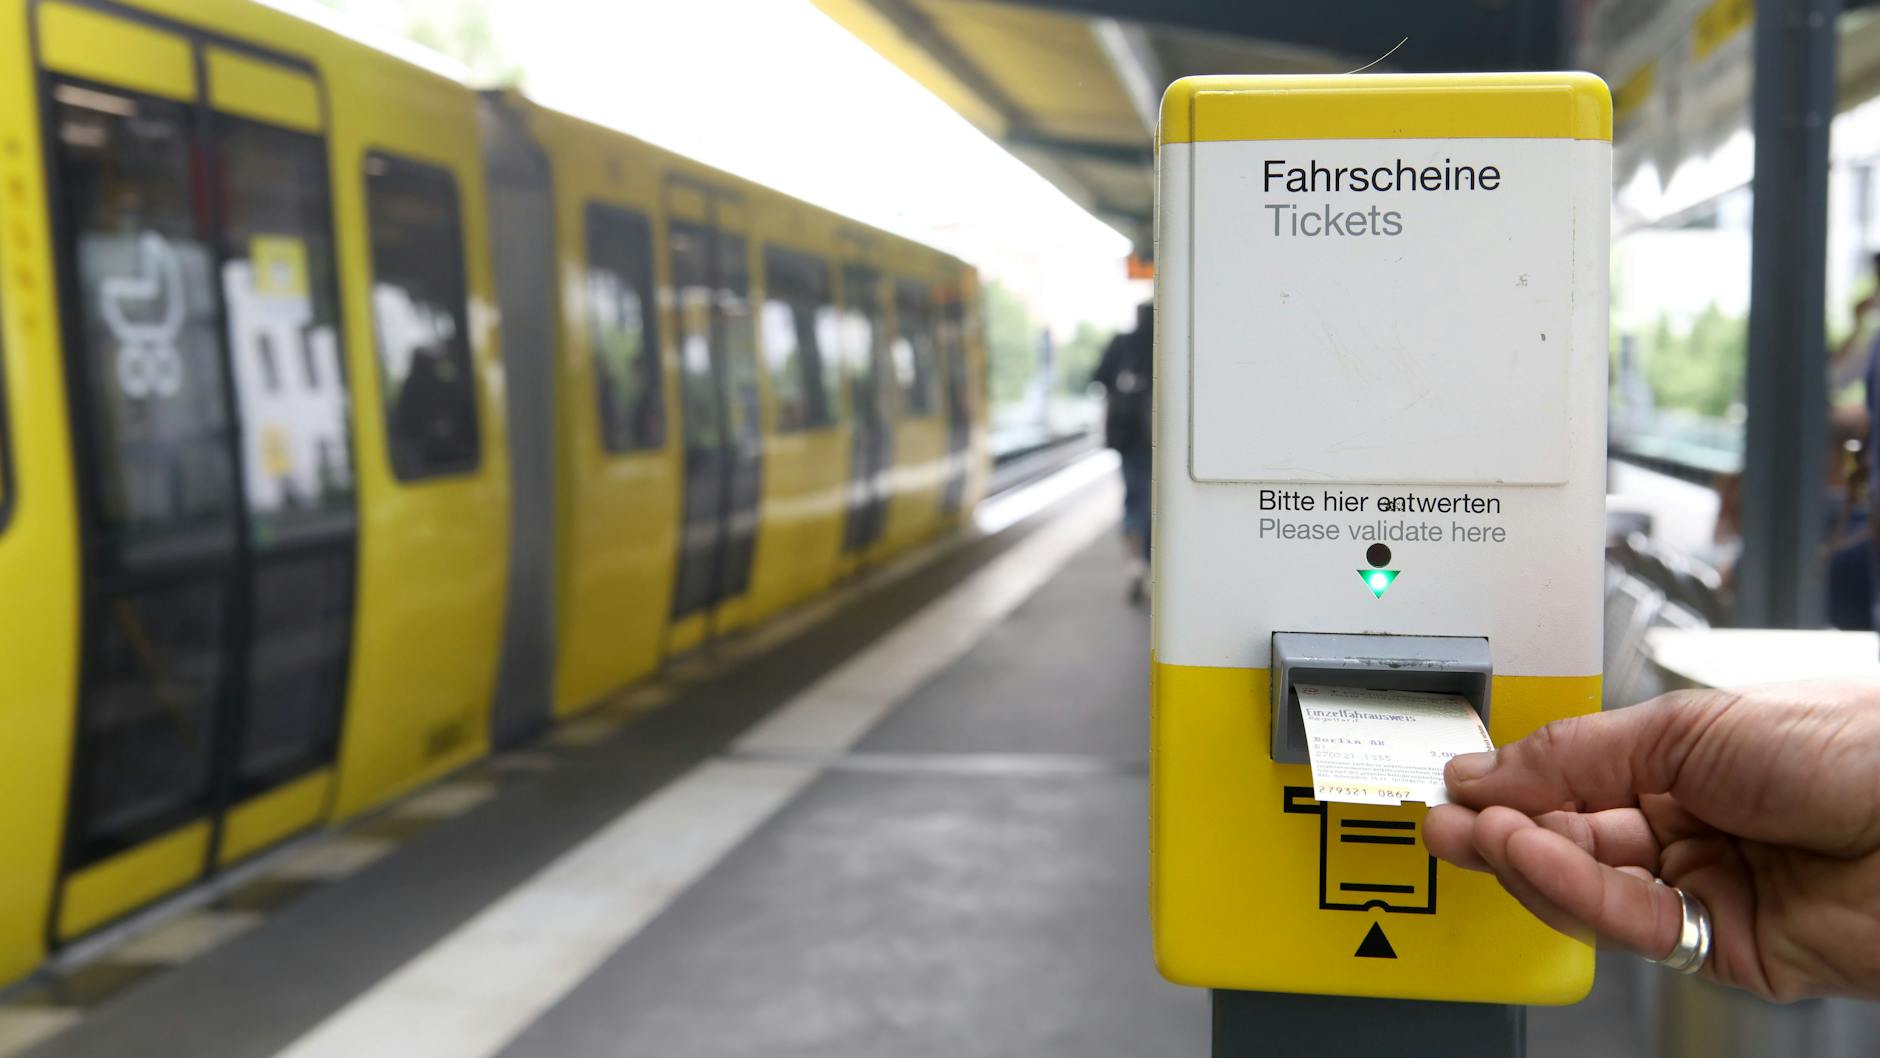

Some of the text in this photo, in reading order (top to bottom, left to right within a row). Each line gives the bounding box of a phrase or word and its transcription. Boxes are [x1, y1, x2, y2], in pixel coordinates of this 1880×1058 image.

[1265, 158, 1500, 192] Fahrscheine
[1265, 204, 1402, 236] Tickets
[1260, 490, 1500, 513] Bitte hier entwerten
[1260, 518, 1505, 542] Please validate here
[1306, 708, 1416, 722] Einzelfahrausweis
[1313, 737, 1362, 745] Berlin
[1319, 786, 1410, 799] 279321 0867
